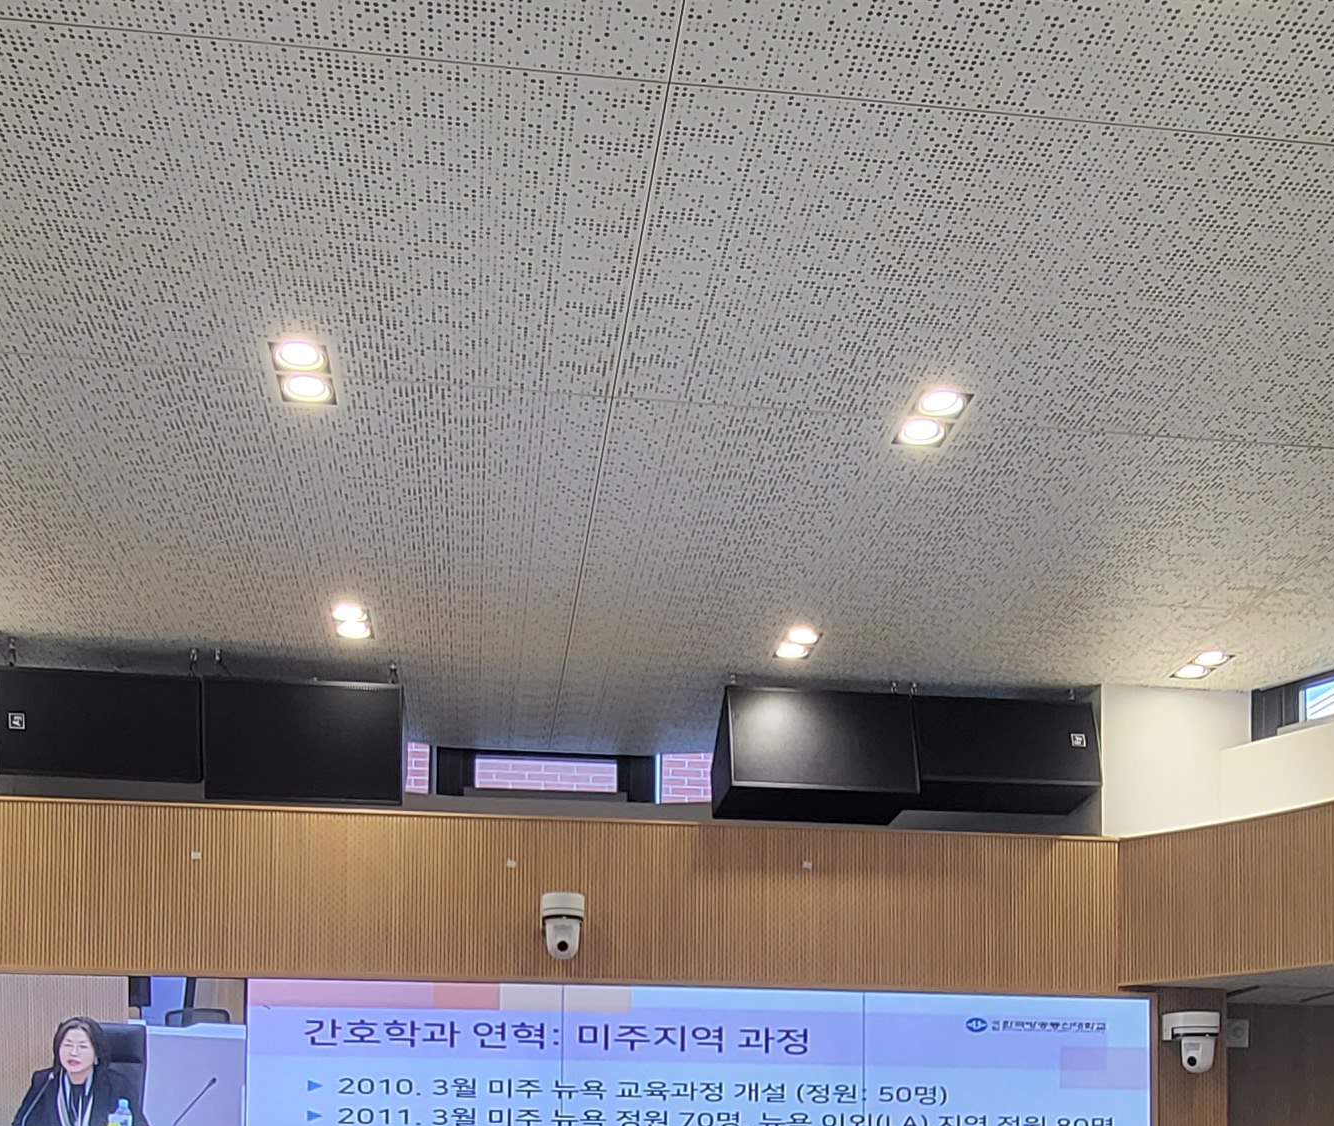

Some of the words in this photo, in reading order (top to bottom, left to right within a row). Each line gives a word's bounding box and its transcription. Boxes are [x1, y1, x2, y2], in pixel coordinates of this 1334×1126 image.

[304, 1018, 461, 1048] 간호학과
[473, 1021, 560, 1050] 연혁:
[578, 1023, 724, 1053] 미주지역
[737, 1027, 809, 1056] 과정
[337, 1077, 421, 1096] 2010.
[432, 1077, 477, 1099] 3월
[488, 1078, 543, 1099] 미주
[551, 1079, 607, 1101] 뉴욕
[615, 1080, 724, 1102] 교육과정
[733, 1082, 786, 1103] 개설
[796, 1083, 867, 1104] (정원:
[878, 1085, 948, 1107] 50명)
[337, 1107, 421, 1126] 2011.
